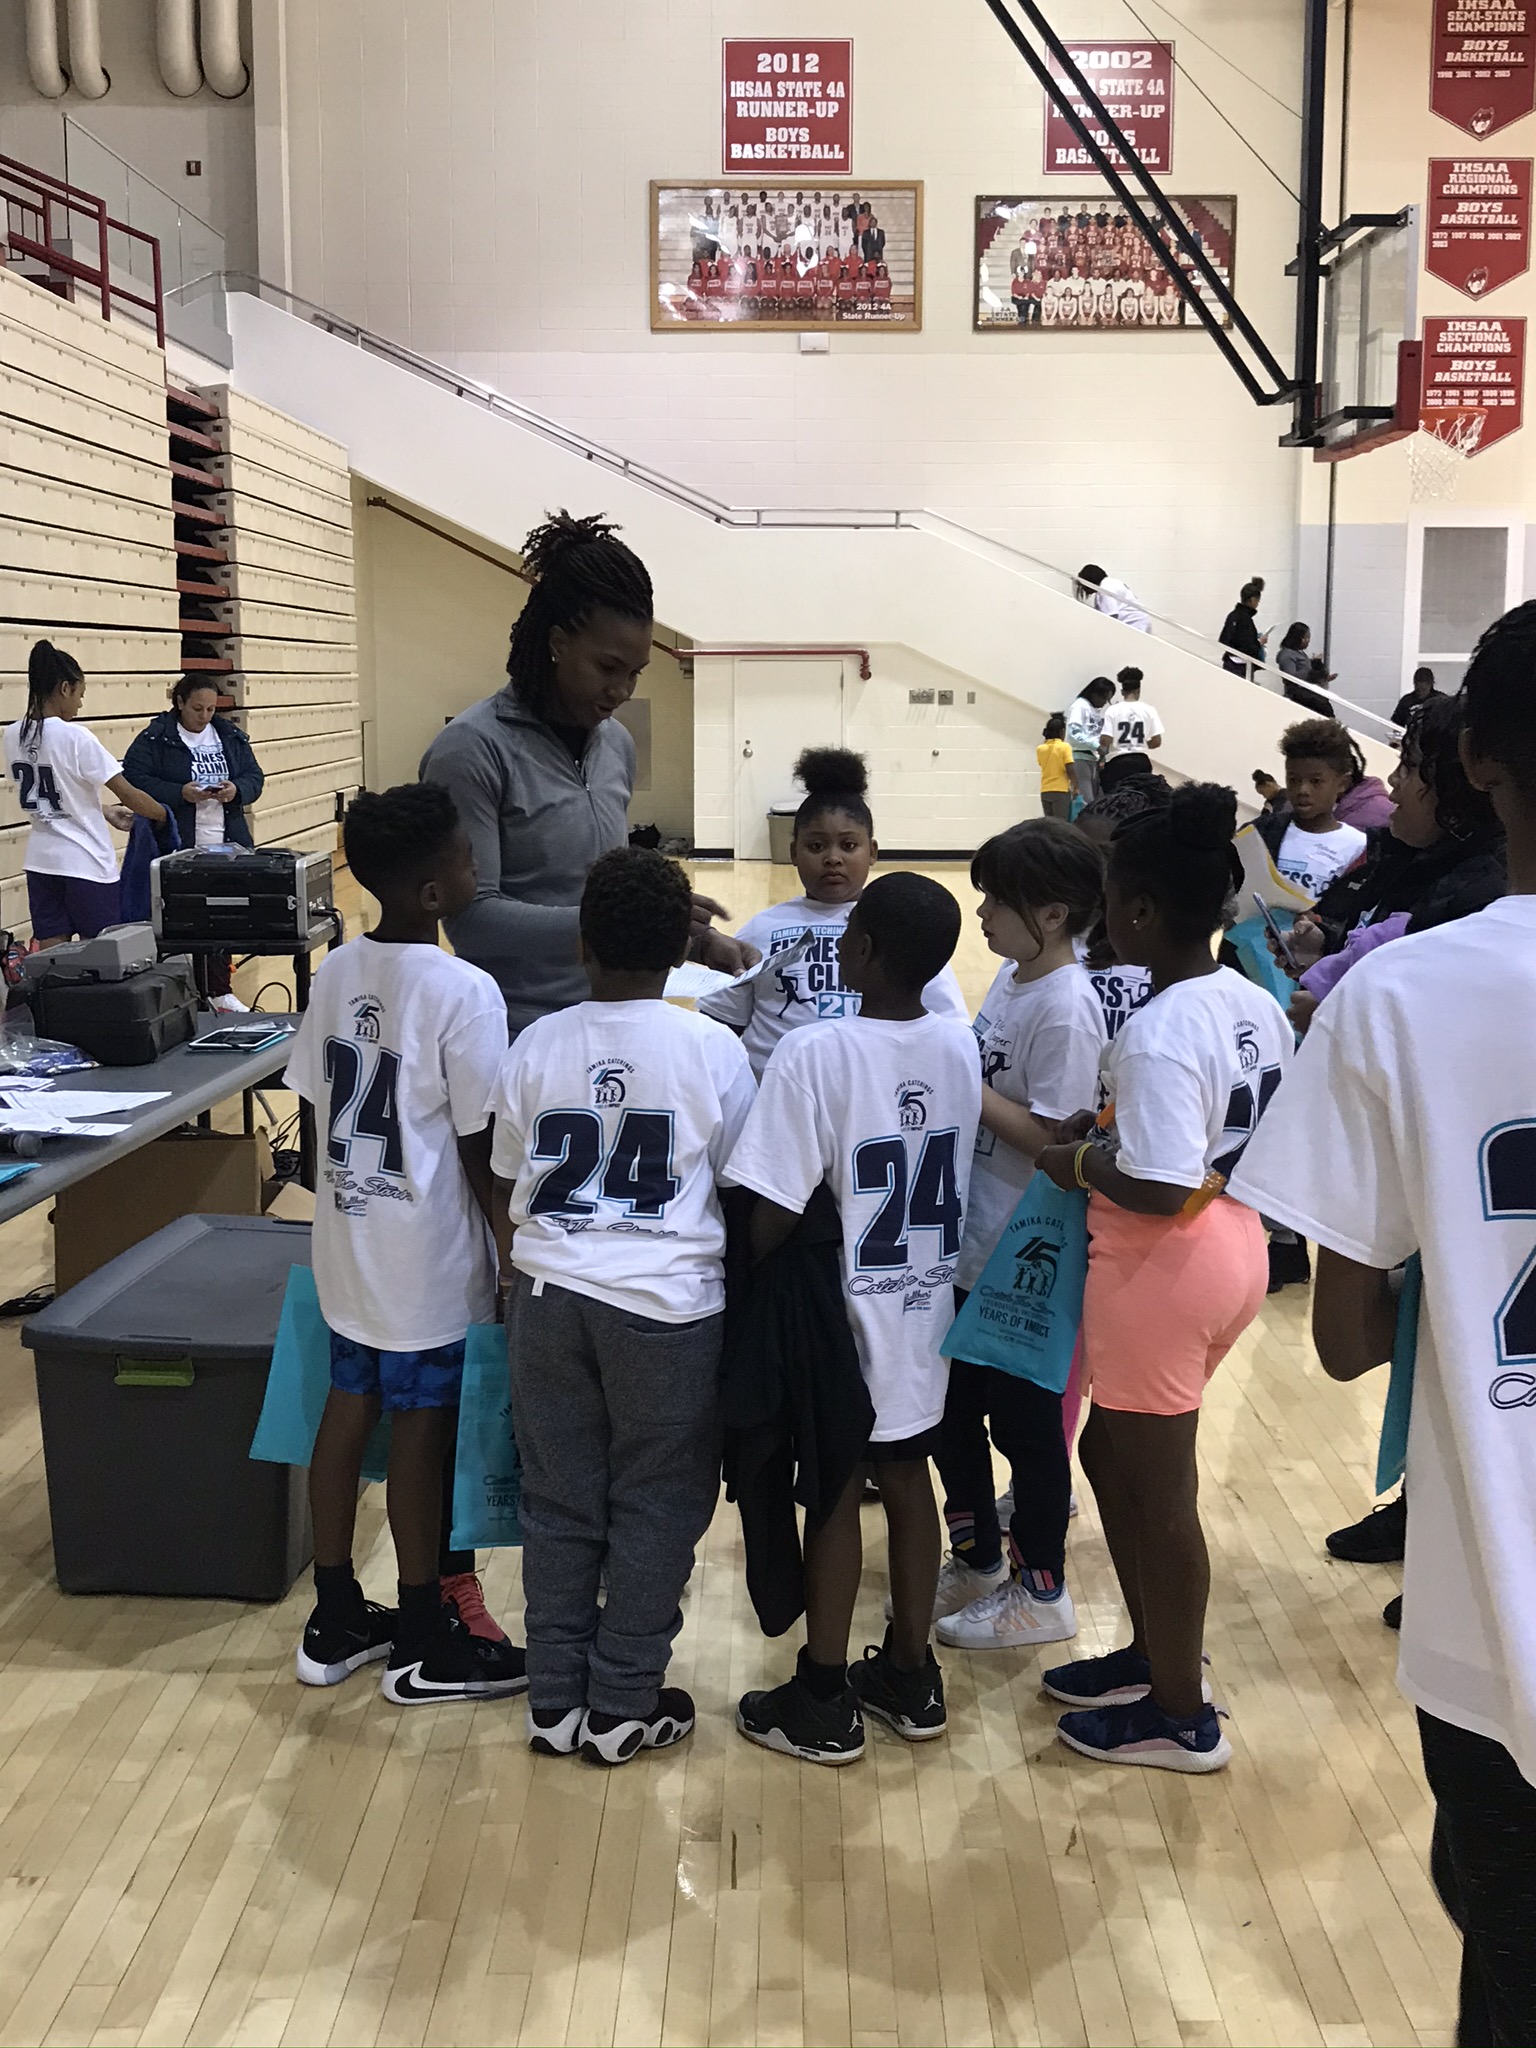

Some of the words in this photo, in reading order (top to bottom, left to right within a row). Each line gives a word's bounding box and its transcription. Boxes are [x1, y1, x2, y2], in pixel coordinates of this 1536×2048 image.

[1457, 0, 1517, 10] IHSAA
[1447, 11, 1526, 21] SEMI-STATE
[1447, 22, 1525, 32] CHAMPIONS
[1462, 40, 1509, 51] BOYS
[1069, 51, 1152, 69] 2002
[1445, 52, 1525, 62] BASKETBALL
[757, 53, 819, 73] 2012
[730, 81, 773, 97] IHSAA
[777, 81, 822, 97] STATE
[826, 81, 845, 97] 4A
[1099, 79, 1143, 95] STATE
[1146, 79, 1165, 95] 4A
[736, 101, 839, 117] RUNNER-UP
[765, 127, 810, 142] BOYS
[730, 143, 844, 159] BASKETBALL
[1453, 163, 1509, 172] IHSAA
[1449, 174, 1513, 183] REGIONAL
[1442, 185, 1518, 194] CHAMPIONS
[1456, 202, 1503, 212] BOYS
[1440, 214, 1518, 224] BASKETBALL
[856, 303, 879, 311] 2012
[880, 303, 892, 311] 4A
[842, 312, 863, 320] State
[864, 312, 906, 321] Runner-Up
[1447, 322, 1502, 331] IHSAA
[1439, 332, 1509, 342] SECTIONAL
[1436, 343, 1512, 352] CHAMPIONS
[1450, 360, 1497, 371] BOYS
[1434, 372, 1512, 382] BASKETBALL
[1117, 721, 1145, 744] 24
[11, 759, 63, 812] 24
[773, 928, 804, 940] TAMIKA
[586, 1059, 606, 1074] TAMIKA
[607, 1058, 635, 1074] CATCHINGS
[907, 1080, 934, 1095] CATCHINGS
[323, 1035, 407, 1179] 24
[526, 1108, 681, 1219] 24
[852, 1126, 964, 1272] 24
[1010, 1216, 1042, 1234] TAMIKA
[980, 1305, 1009, 1325] YEARS
[1010, 1315, 1023, 1328] OF
